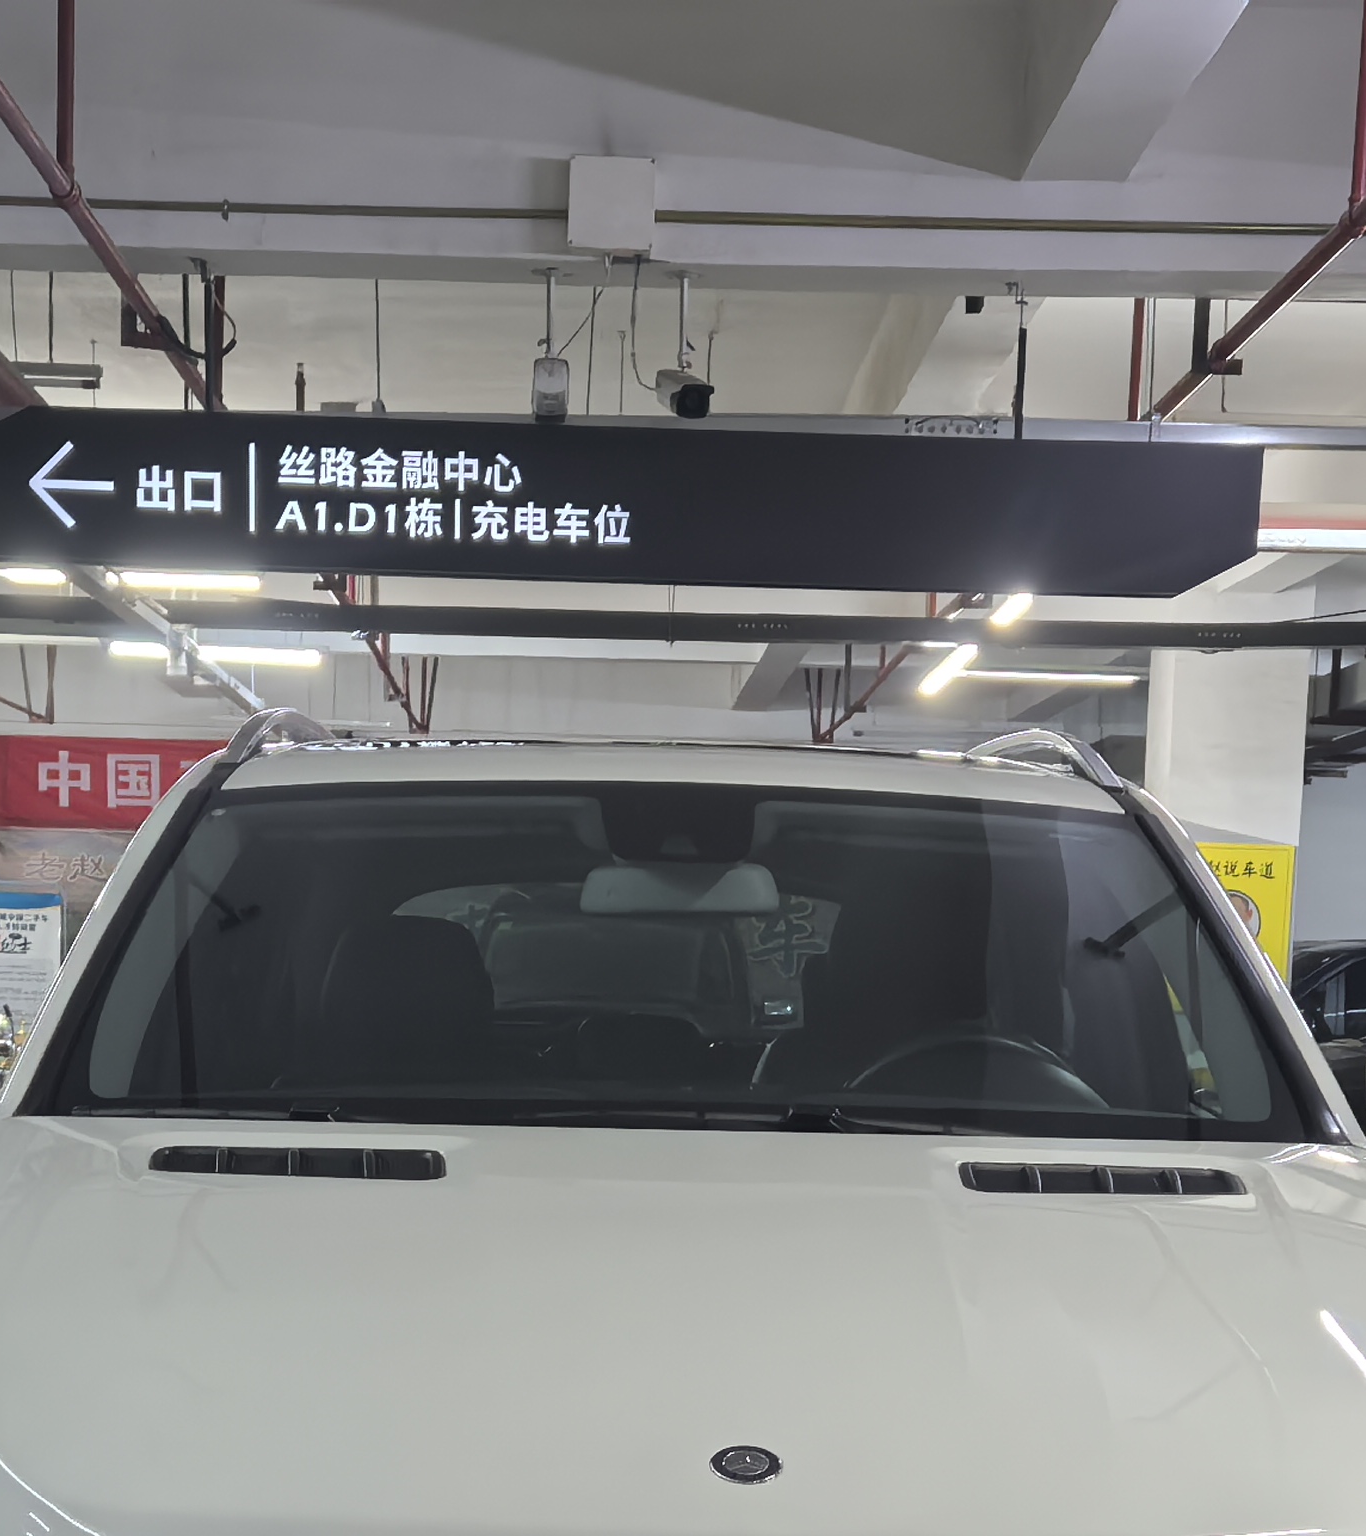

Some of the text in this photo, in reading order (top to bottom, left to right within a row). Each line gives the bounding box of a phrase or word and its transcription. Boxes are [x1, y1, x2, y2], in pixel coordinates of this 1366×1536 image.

[136, 464, 222, 512] 出口
[278, 444, 522, 493] 丝路金融中心
[38, 751, 197, 809] 中国
[24, 852, 109, 883] 老赵
